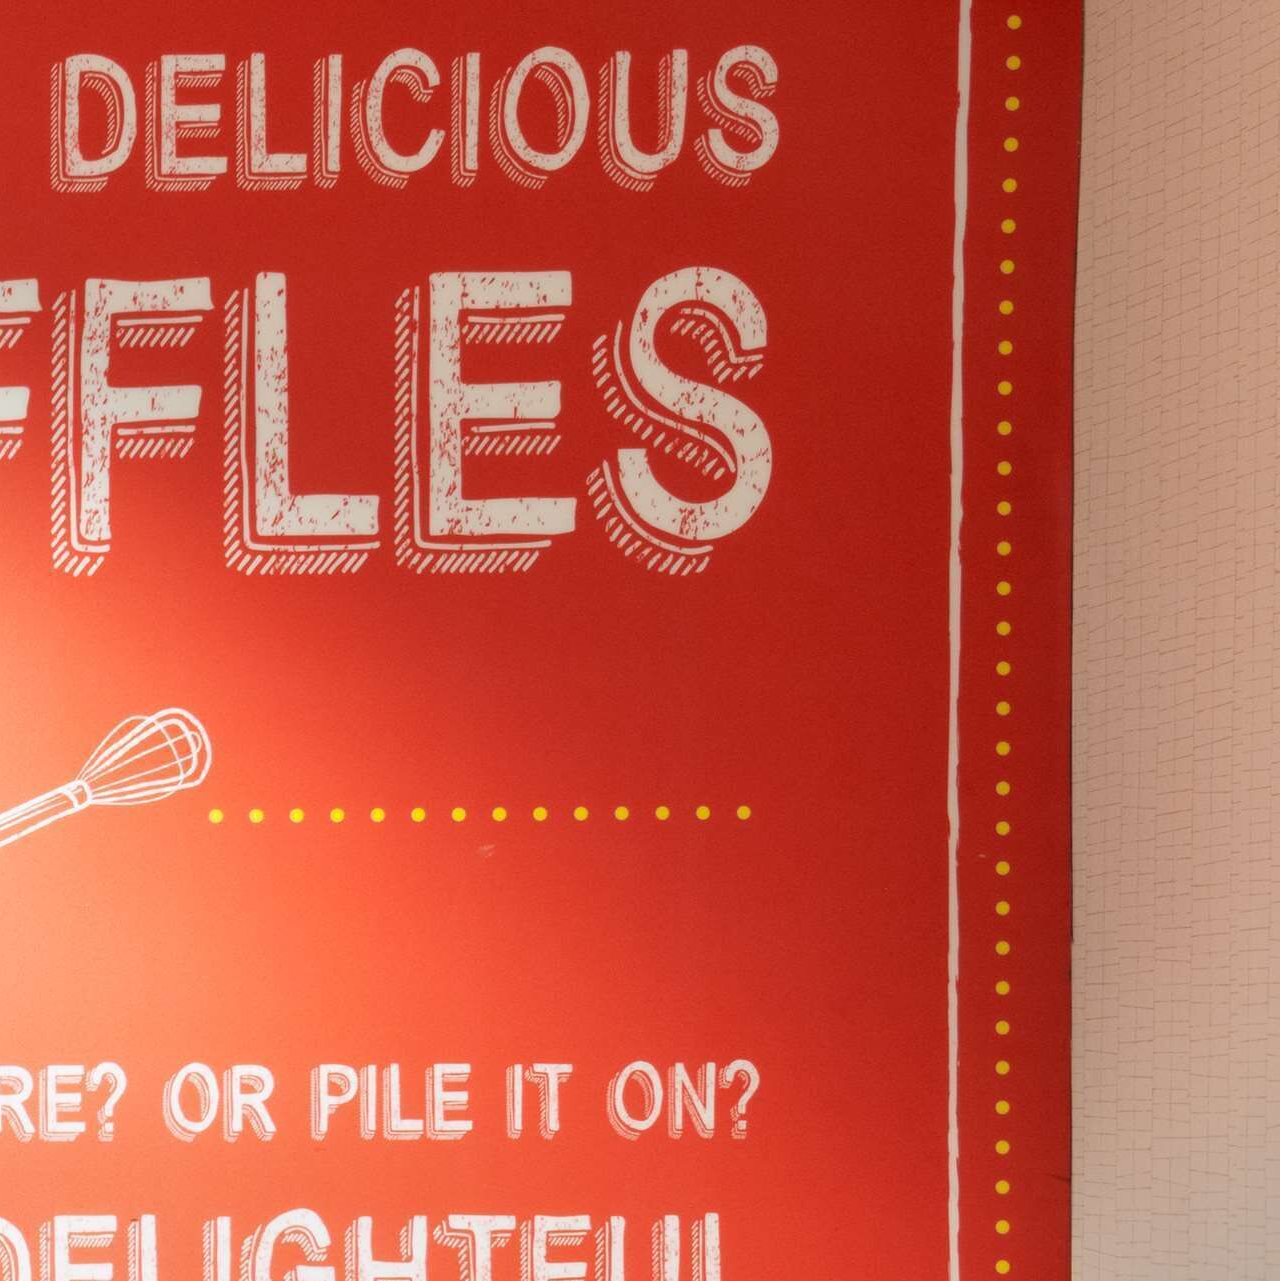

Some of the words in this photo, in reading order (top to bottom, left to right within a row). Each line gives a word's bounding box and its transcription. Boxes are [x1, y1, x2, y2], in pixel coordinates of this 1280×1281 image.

[50, 45, 780, 192] DELICIOUS
[162, 1062, 277, 1141] OR
[310, 1063, 473, 1141] PILE
[506, 1062, 574, 1140] IT
[606, 1059, 761, 1140] ON?
